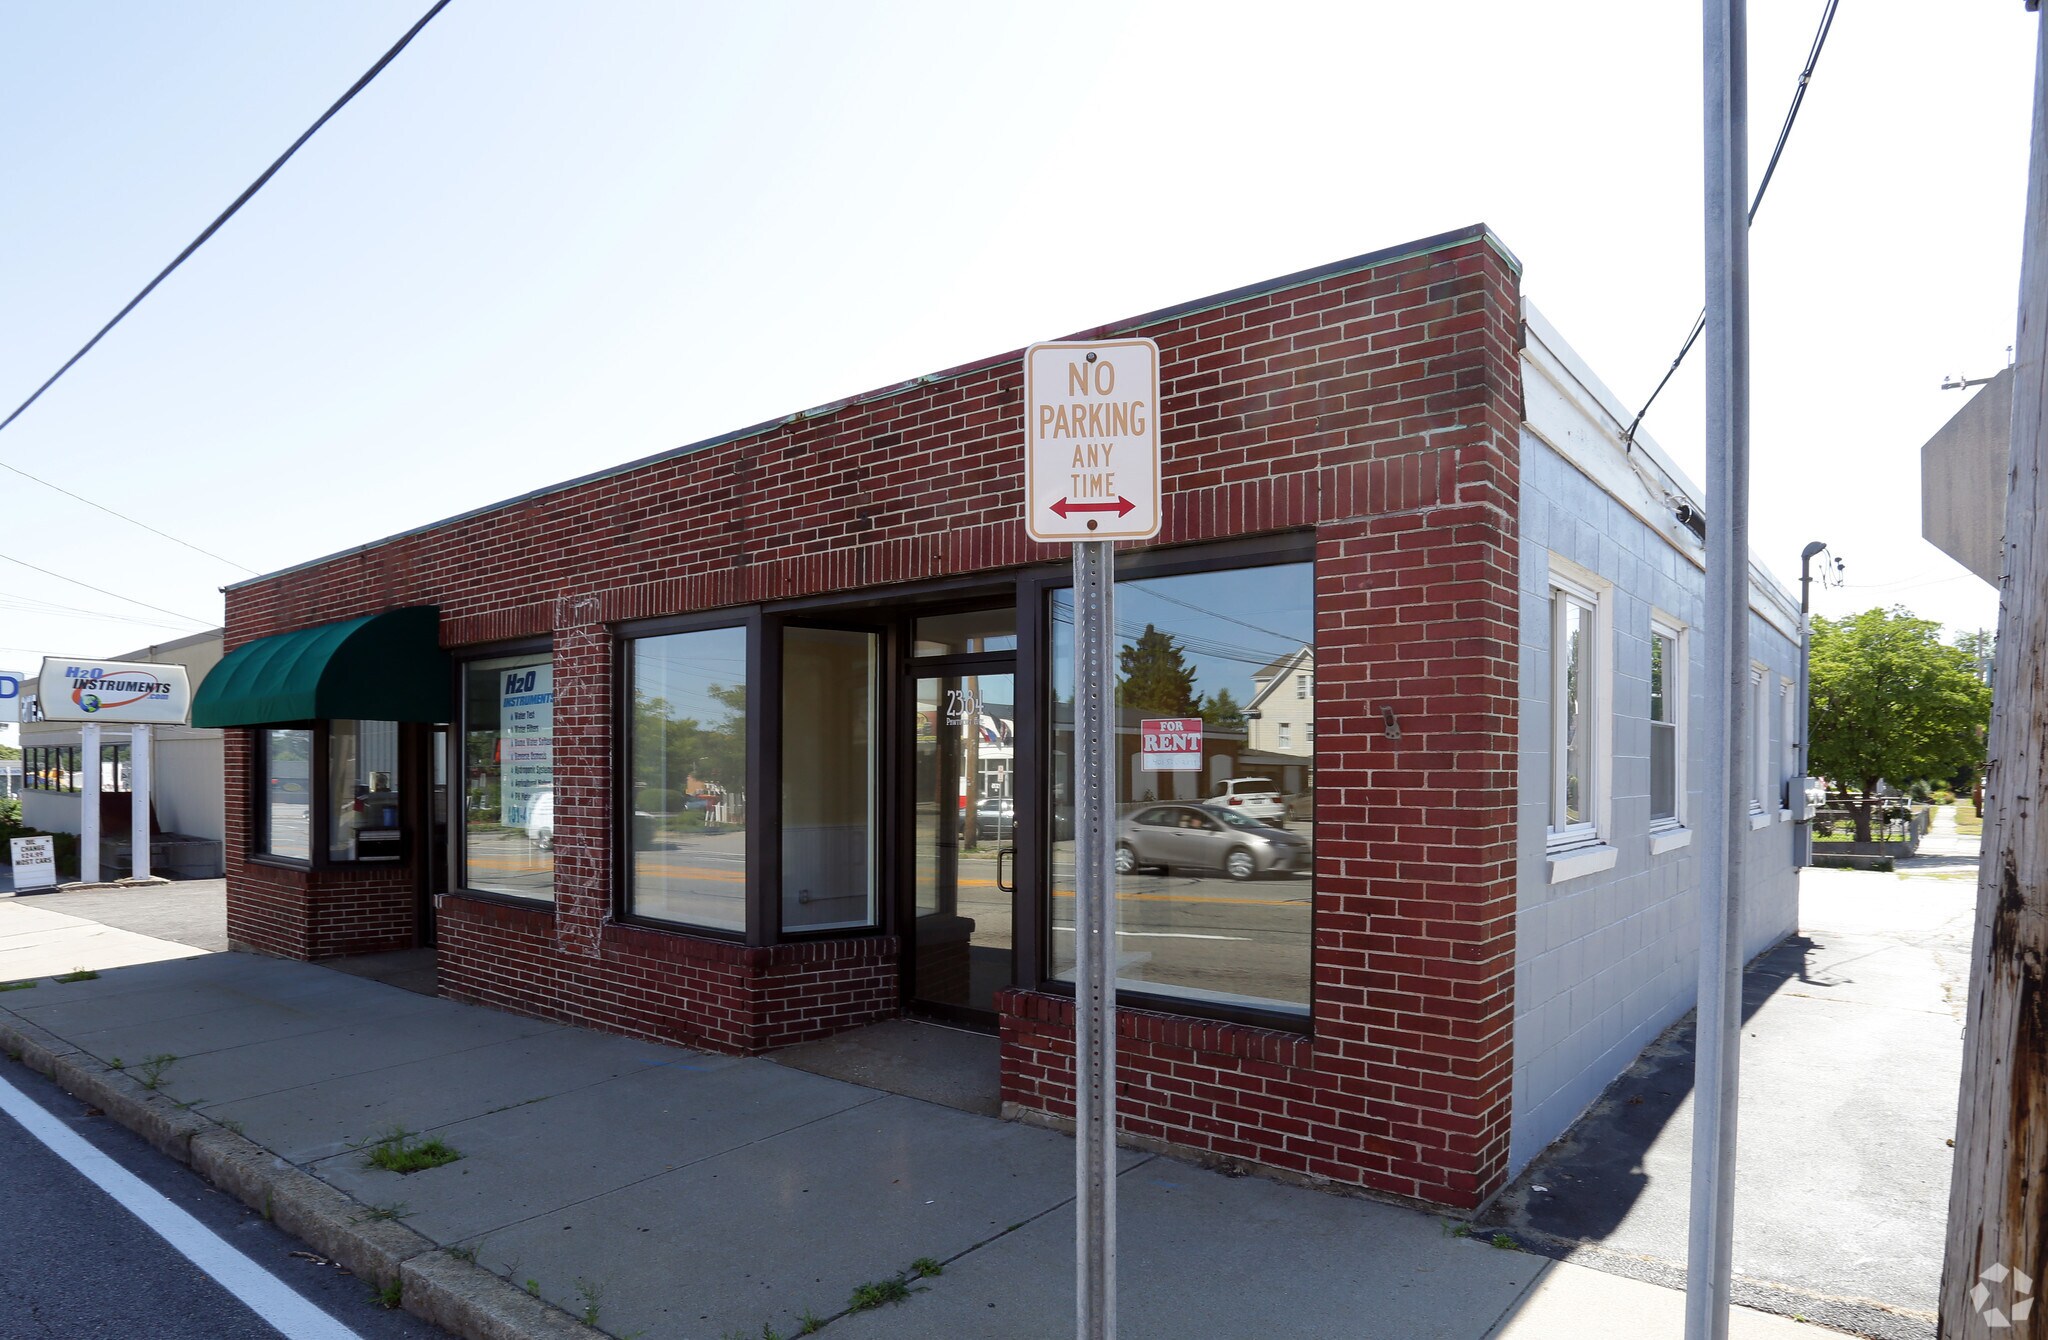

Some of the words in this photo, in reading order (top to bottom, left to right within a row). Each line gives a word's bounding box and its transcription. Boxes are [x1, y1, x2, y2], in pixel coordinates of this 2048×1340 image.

[1068, 360, 1115, 396] NO
[1039, 400, 1146, 439] PARKING
[1072, 443, 1114, 468] ANY
[1070, 472, 1116, 498] TIME
[65, 666, 104, 680] H2O
[505, 670, 536, 695] H2O
[72, 678, 171, 694] INSTRUMENTS
[946, 689, 985, 716] 2384
[514, 711, 526, 721] Water
[526, 710, 535, 719] Test
[1160, 721, 1184, 731] FOR
[1143, 732, 1201, 752] RENT
